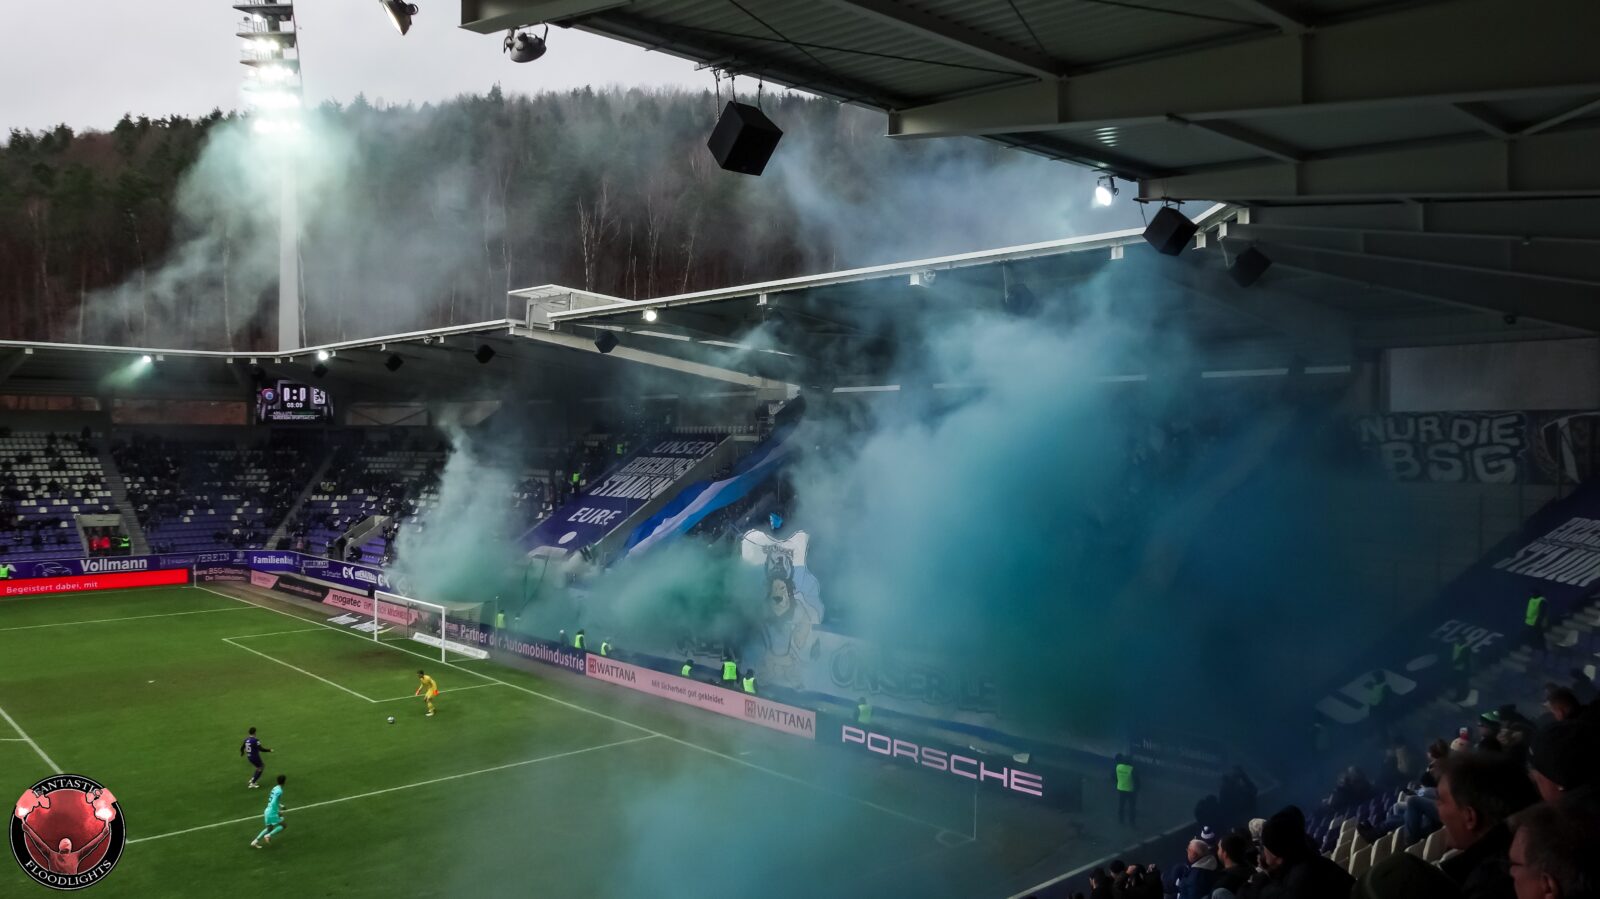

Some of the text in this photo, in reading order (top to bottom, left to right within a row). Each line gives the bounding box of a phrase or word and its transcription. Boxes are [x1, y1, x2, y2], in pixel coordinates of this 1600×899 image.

[1360, 415, 1520, 447] NUR DIE
[652, 441, 716, 455] UNSER
[1381, 441, 1516, 484] BSG
[588, 474, 674, 501] STADION
[567, 507, 622, 526] EURE
[80, 559, 147, 572] Vollmann
[6, 585, 53, 594] Begeistert
[55, 582, 81, 590] dabei,
[332, 593, 361, 607] mogatec
[460, 624, 487, 643] Partner
[503, 636, 585, 671] Automobilindustrie
[597, 662, 636, 683] WATTANA
[651, 679, 660, 688] Mit
[687, 689, 697, 698] gut
[757, 703, 813, 732] WATTANA
[841, 724, 1043, 797] PORSCHE
